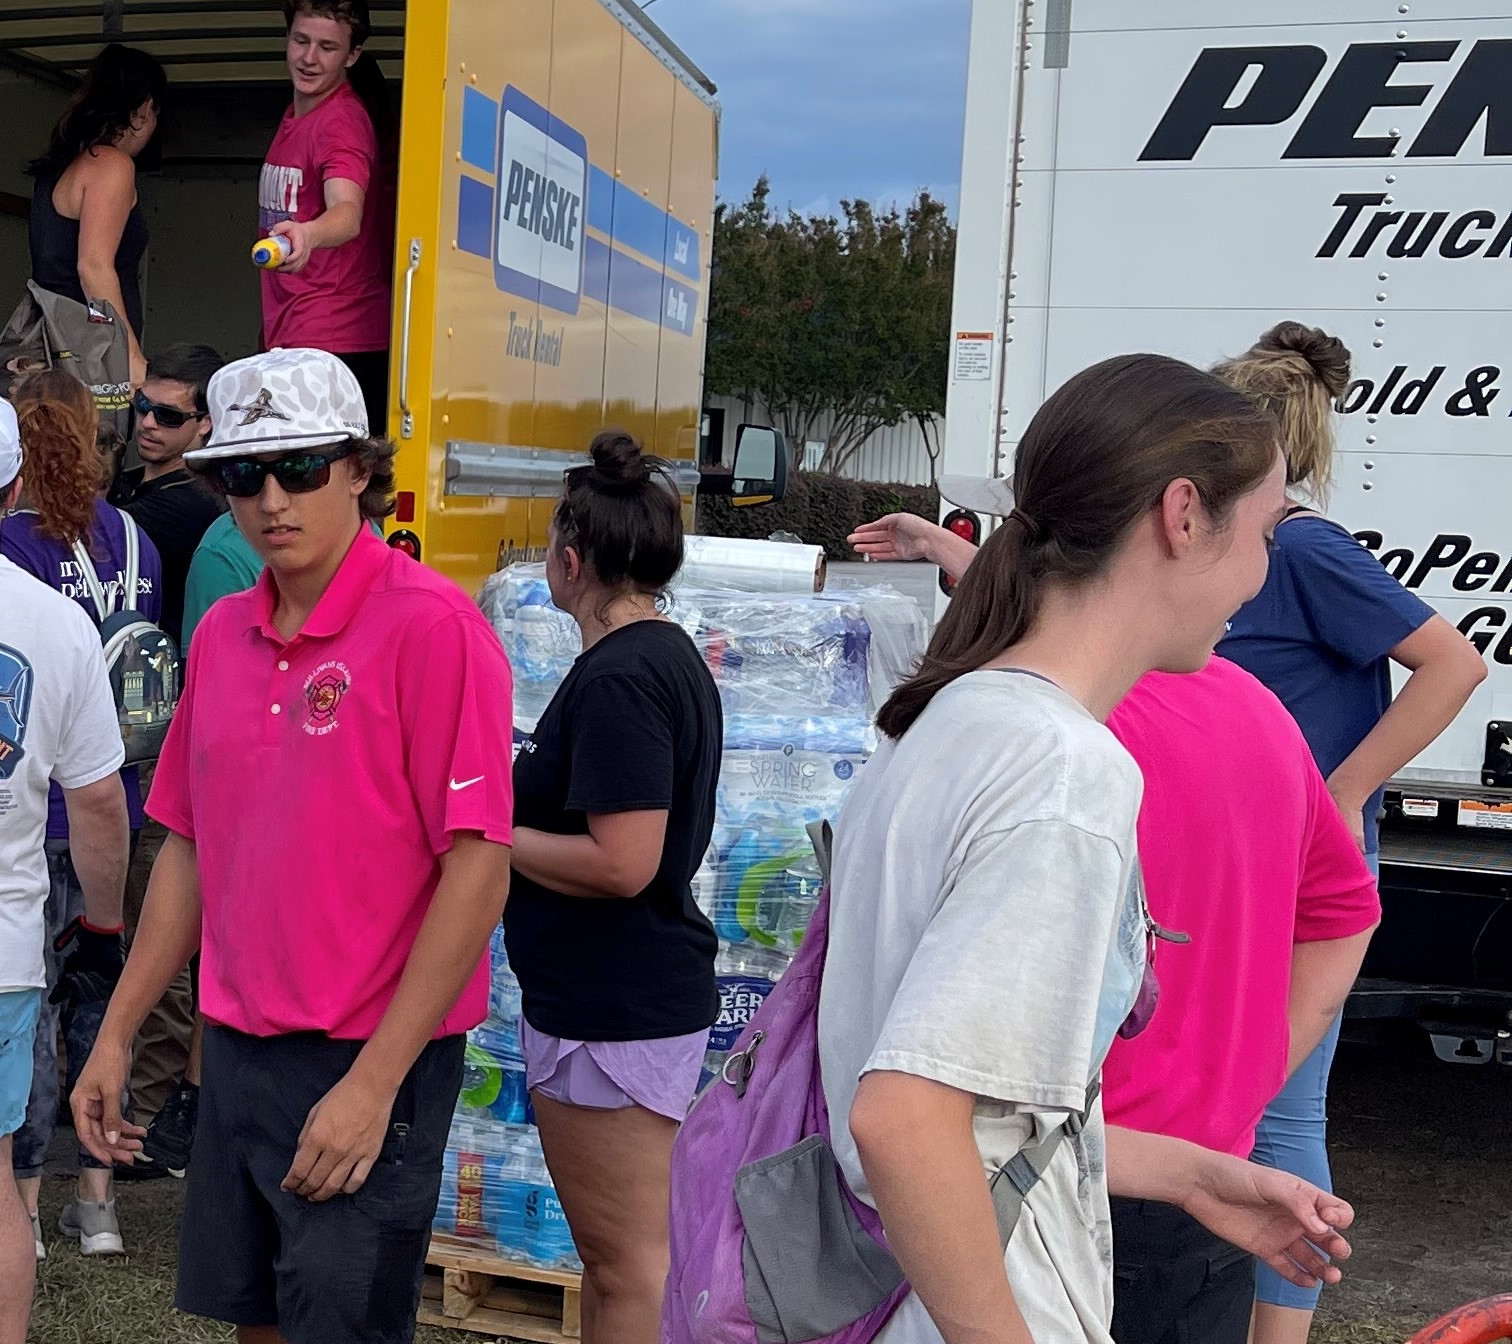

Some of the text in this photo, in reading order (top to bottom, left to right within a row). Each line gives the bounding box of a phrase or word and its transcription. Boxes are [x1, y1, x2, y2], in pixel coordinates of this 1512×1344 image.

[503, 159, 581, 251] PENSKE
[506, 310, 566, 367] Truck Rental
[1445, 365, 1501, 417] &
[749, 760, 817, 778] SPRING
[752, 775, 812, 792] WATER
[719, 993, 764, 1009] EER
[715, 1008, 756, 1025] AR
